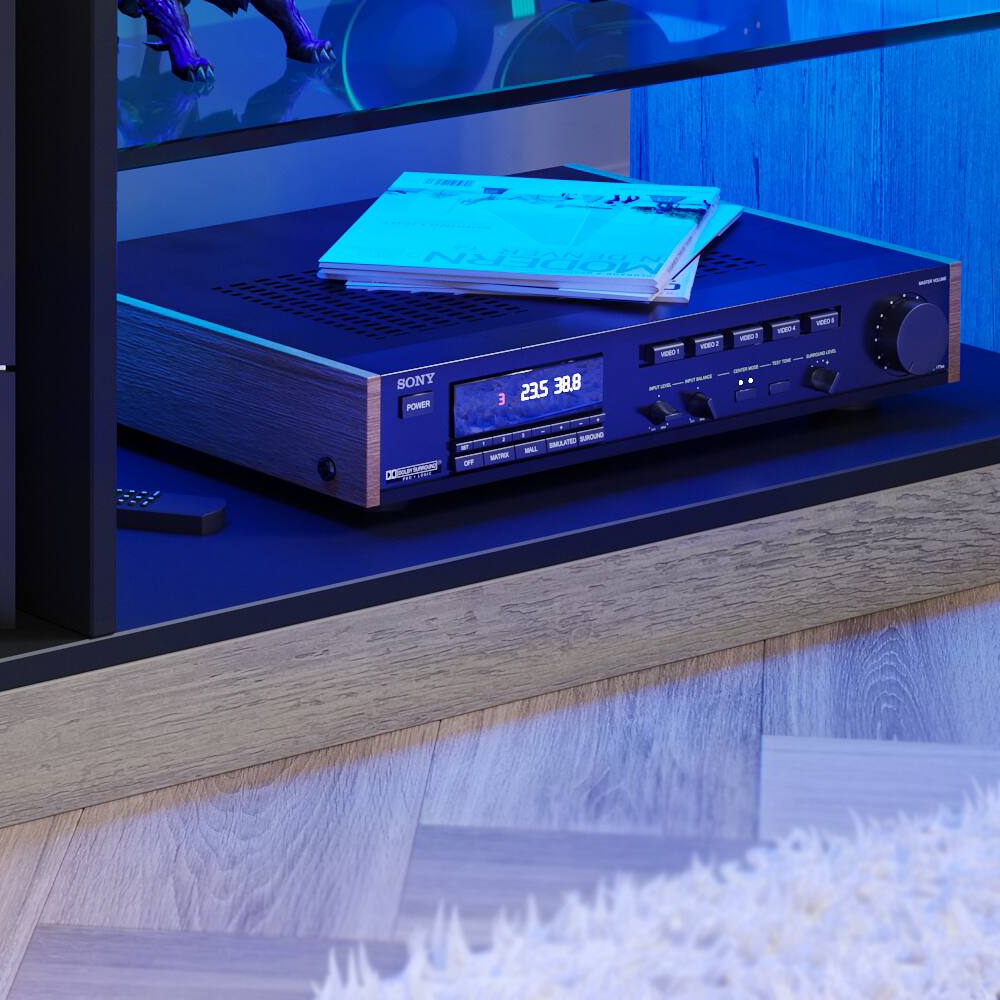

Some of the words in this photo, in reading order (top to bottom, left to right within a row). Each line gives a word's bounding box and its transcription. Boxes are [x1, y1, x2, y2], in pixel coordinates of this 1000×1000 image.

[815, 318, 830, 326] VIDEO
[777, 326, 792, 334] VIDEO
[740, 334, 754, 342] VIDEO
[700, 342, 715, 350] VIDEO
[660, 349, 676, 358] VIDEO
[397, 372, 435, 390] SONY
[498, 392, 505, 405] 3
[406, 400, 431, 412] POWER
[490, 452, 509, 461] MATRIX
[463, 459, 474, 467] OFF
